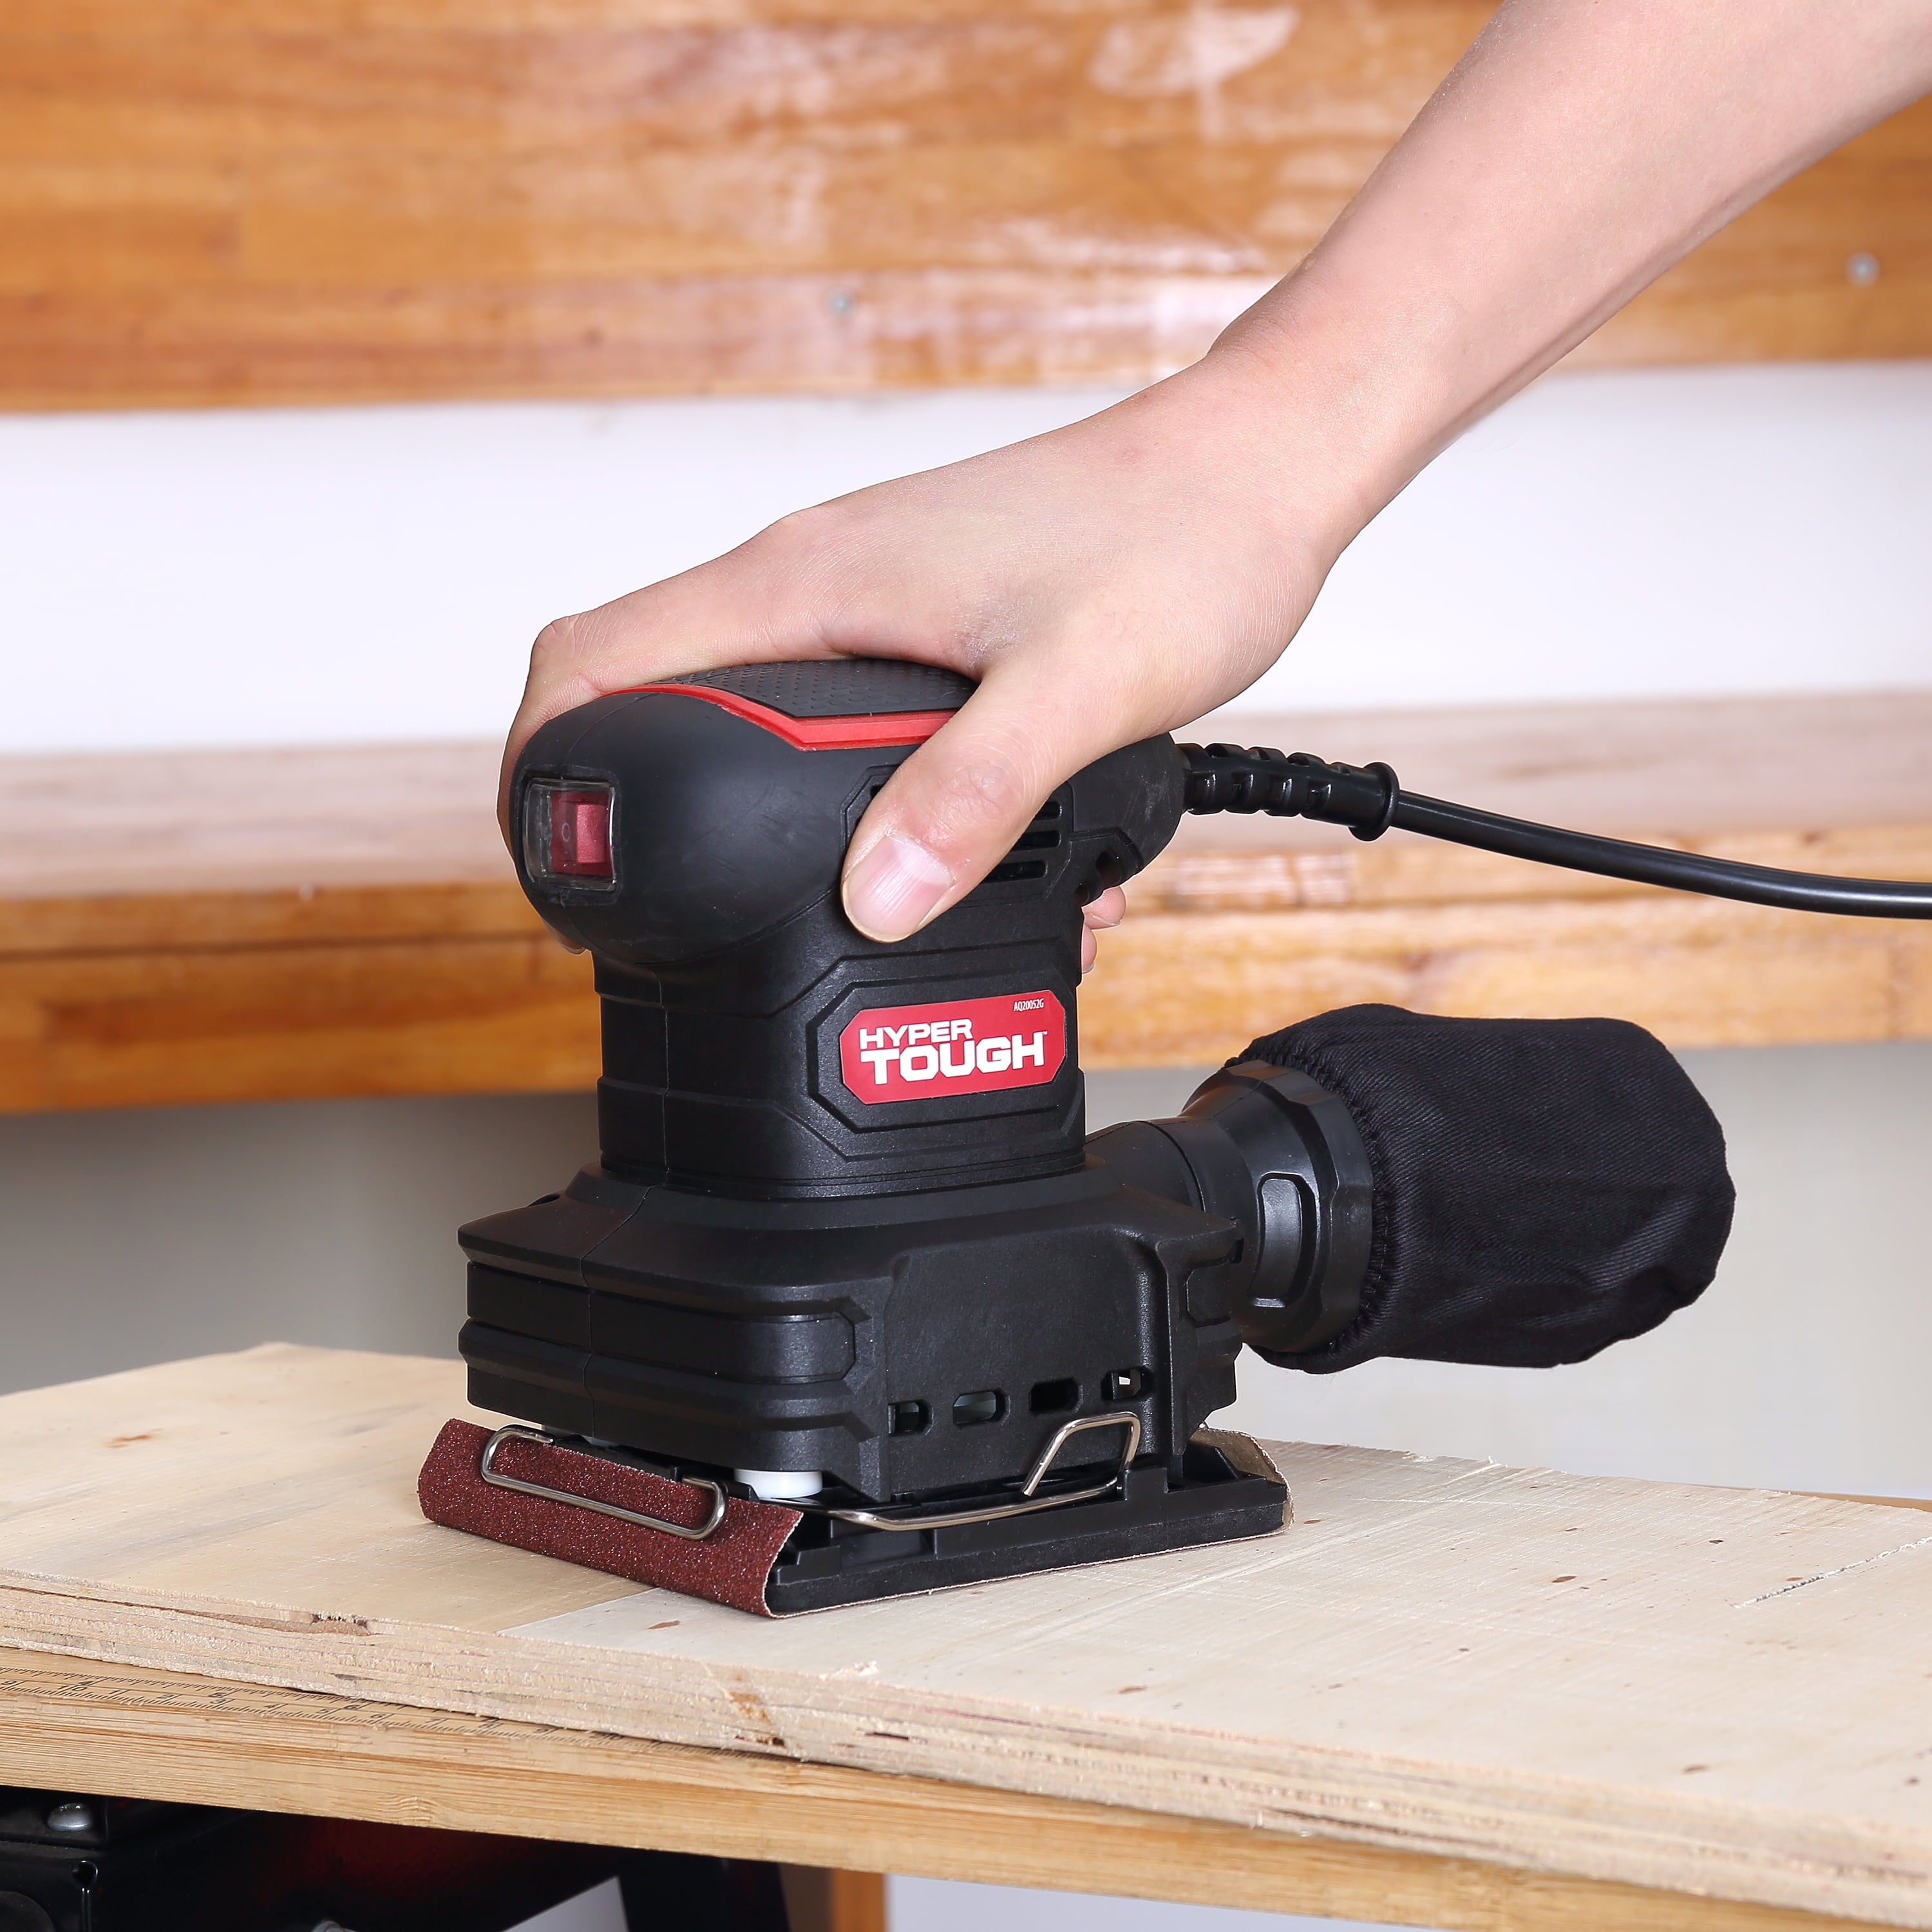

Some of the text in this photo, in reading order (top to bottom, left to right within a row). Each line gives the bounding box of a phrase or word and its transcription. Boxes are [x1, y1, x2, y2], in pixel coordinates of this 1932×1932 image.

[1013, 998, 1045, 1012] AQ20052G
[859, 1018, 974, 1049] HYPER
[860, 1032, 1045, 1084] TOUGH
